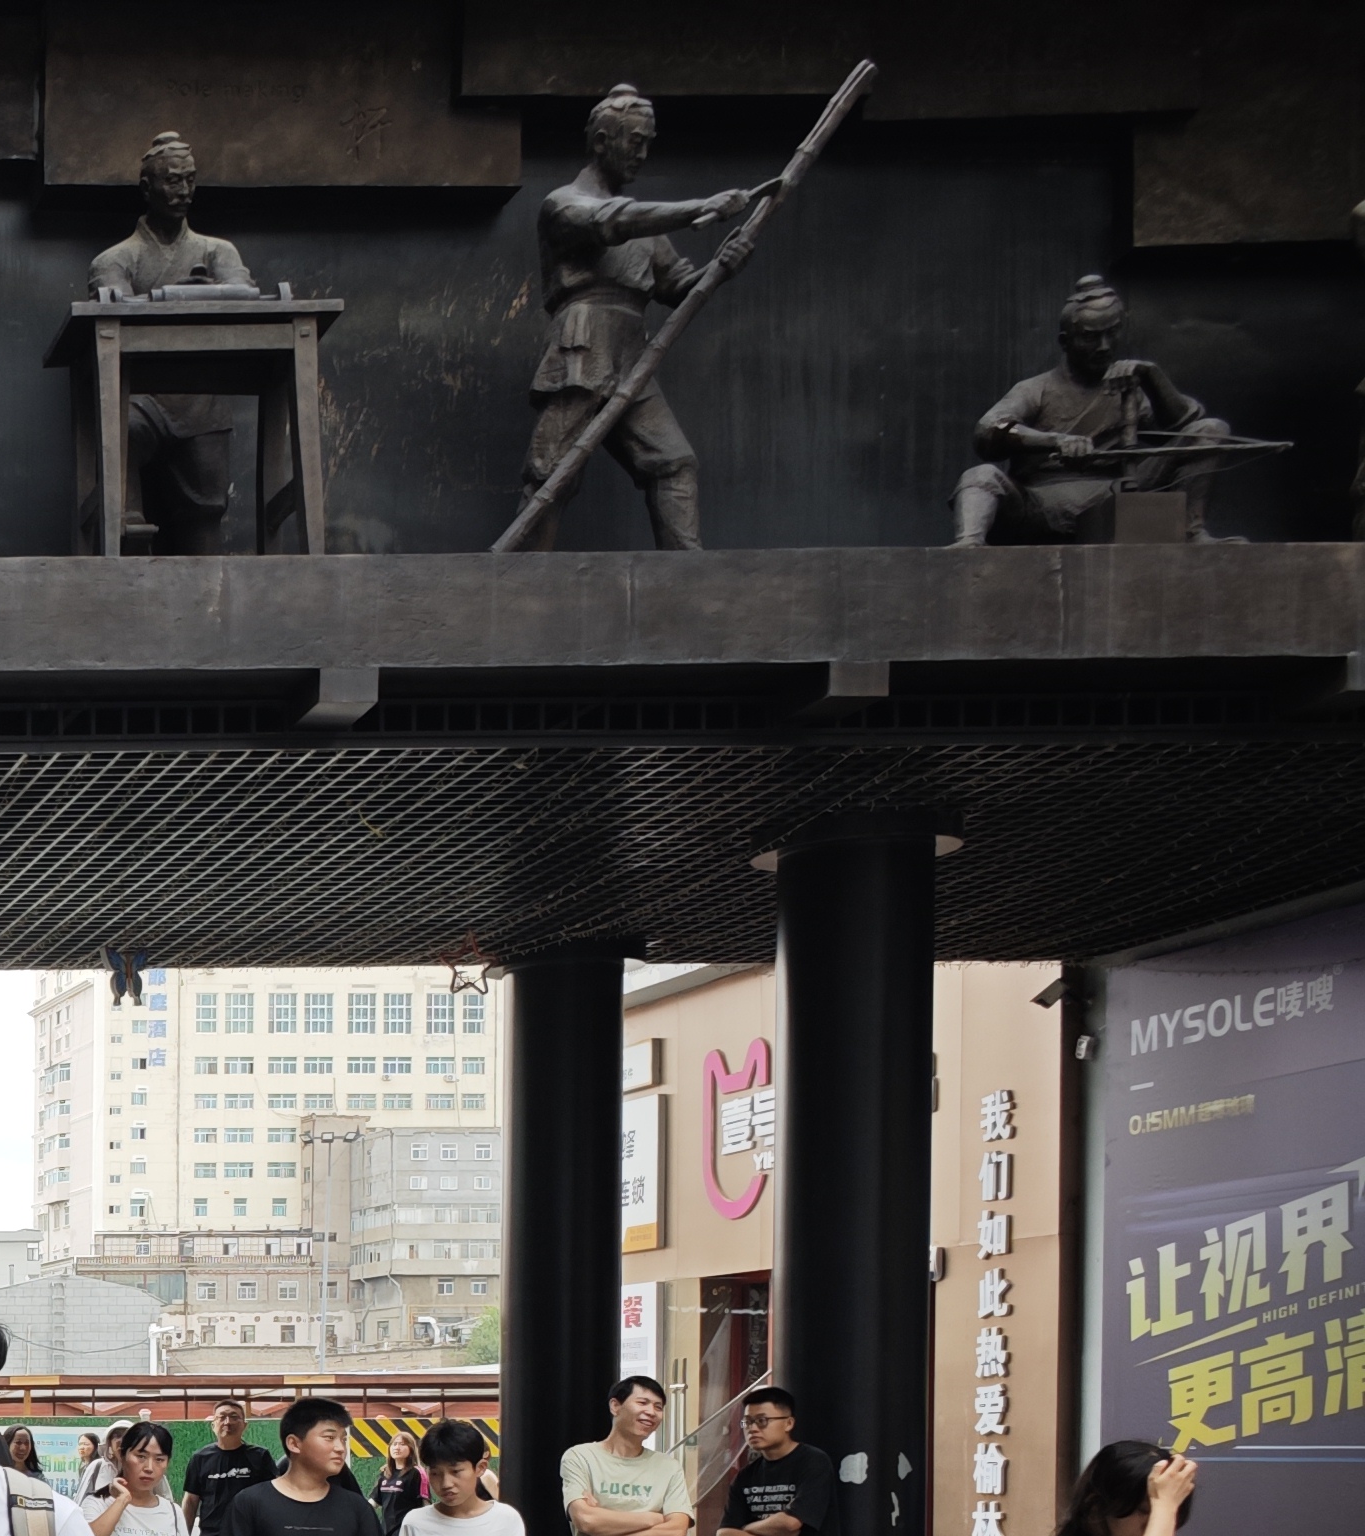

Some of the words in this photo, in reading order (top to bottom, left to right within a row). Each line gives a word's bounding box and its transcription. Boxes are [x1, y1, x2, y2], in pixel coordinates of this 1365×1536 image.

[1126, 1181, 1353, 1342] 让视界
[1262, 1302, 1299, 1324] HIGH
[1307, 1280, 1365, 1310] DEFINI
[600, 1482, 653, 1498] LUCKY
